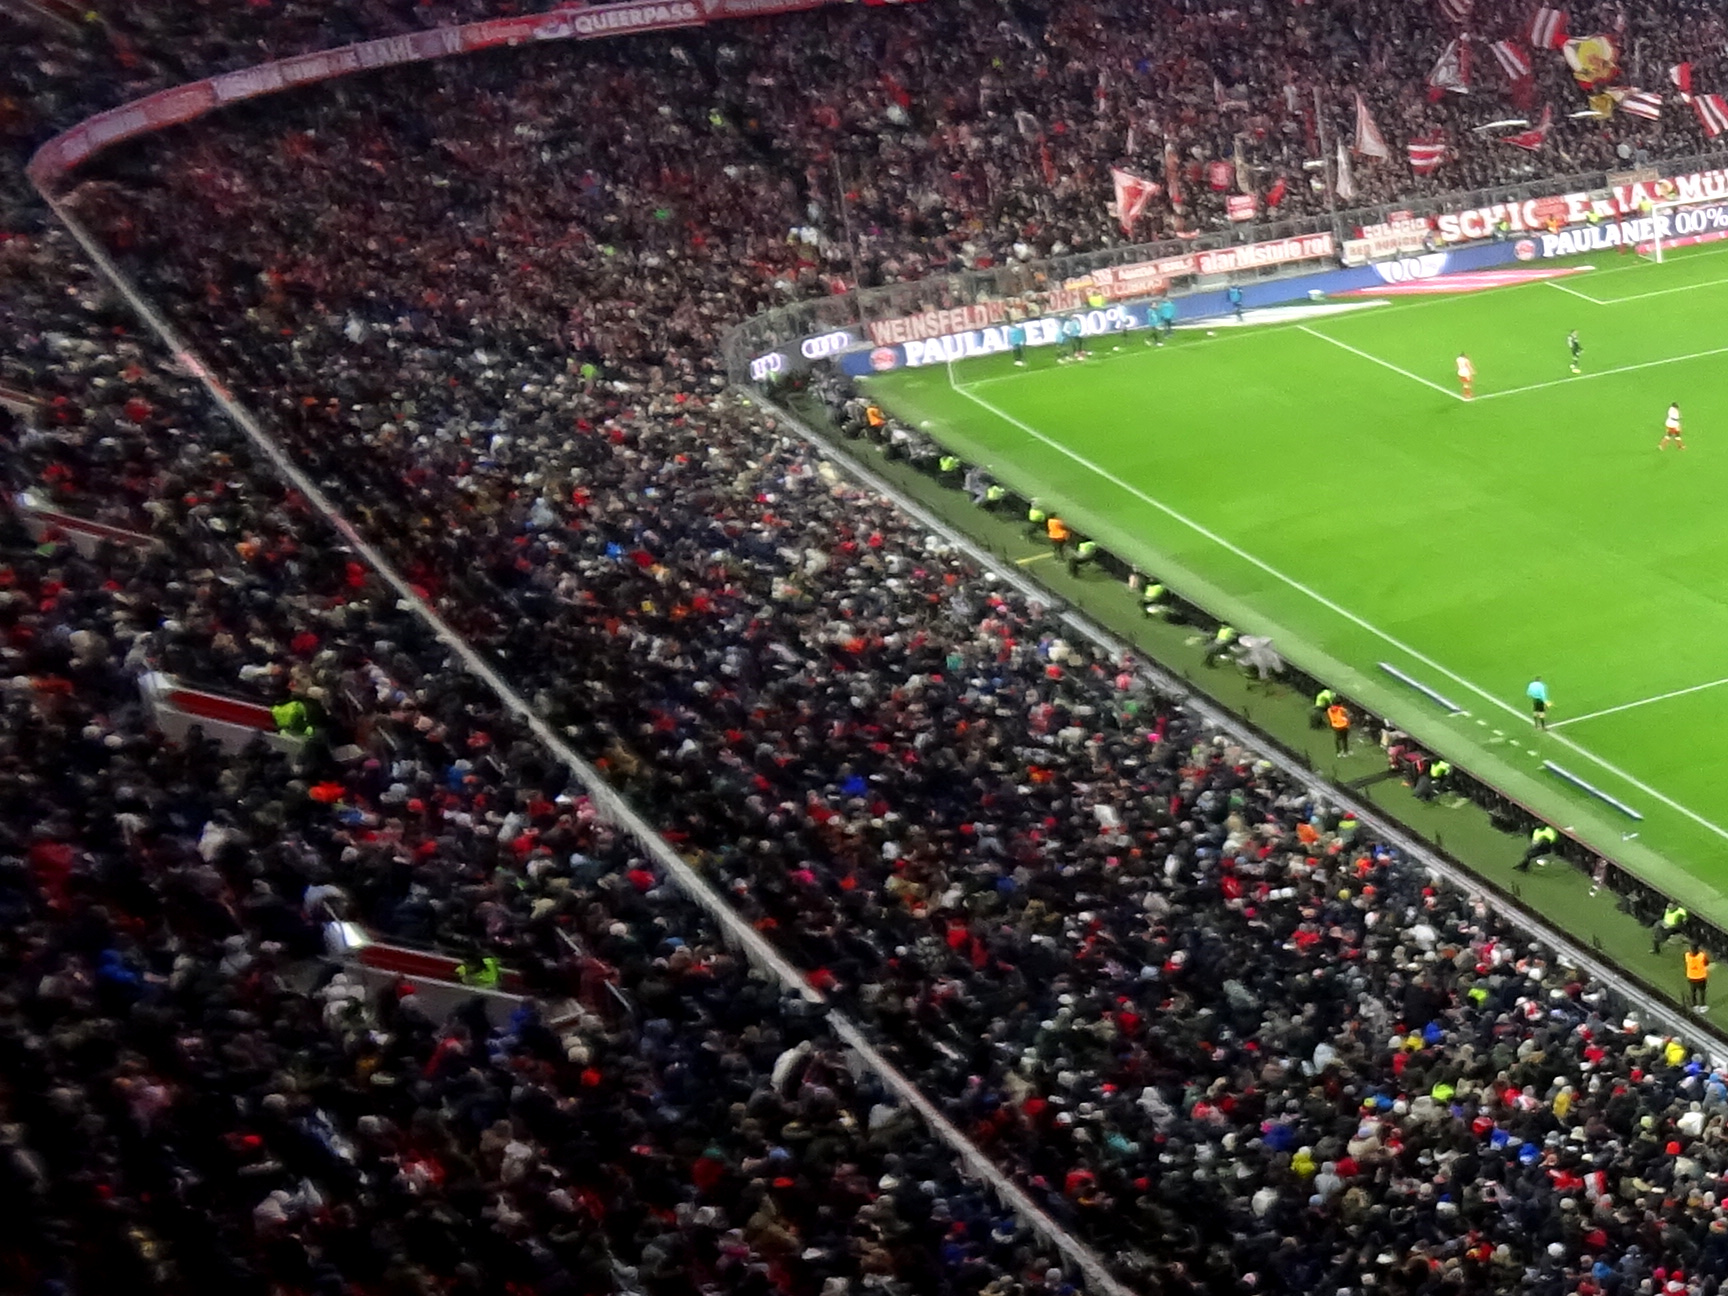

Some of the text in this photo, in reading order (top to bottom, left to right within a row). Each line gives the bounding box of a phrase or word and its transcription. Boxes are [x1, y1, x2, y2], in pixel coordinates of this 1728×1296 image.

[574, 2, 698, 34] QUEERPASS
[1438, 181, 1652, 241] SCHICERIA
[1542, 216, 1672, 256] PAULANER
